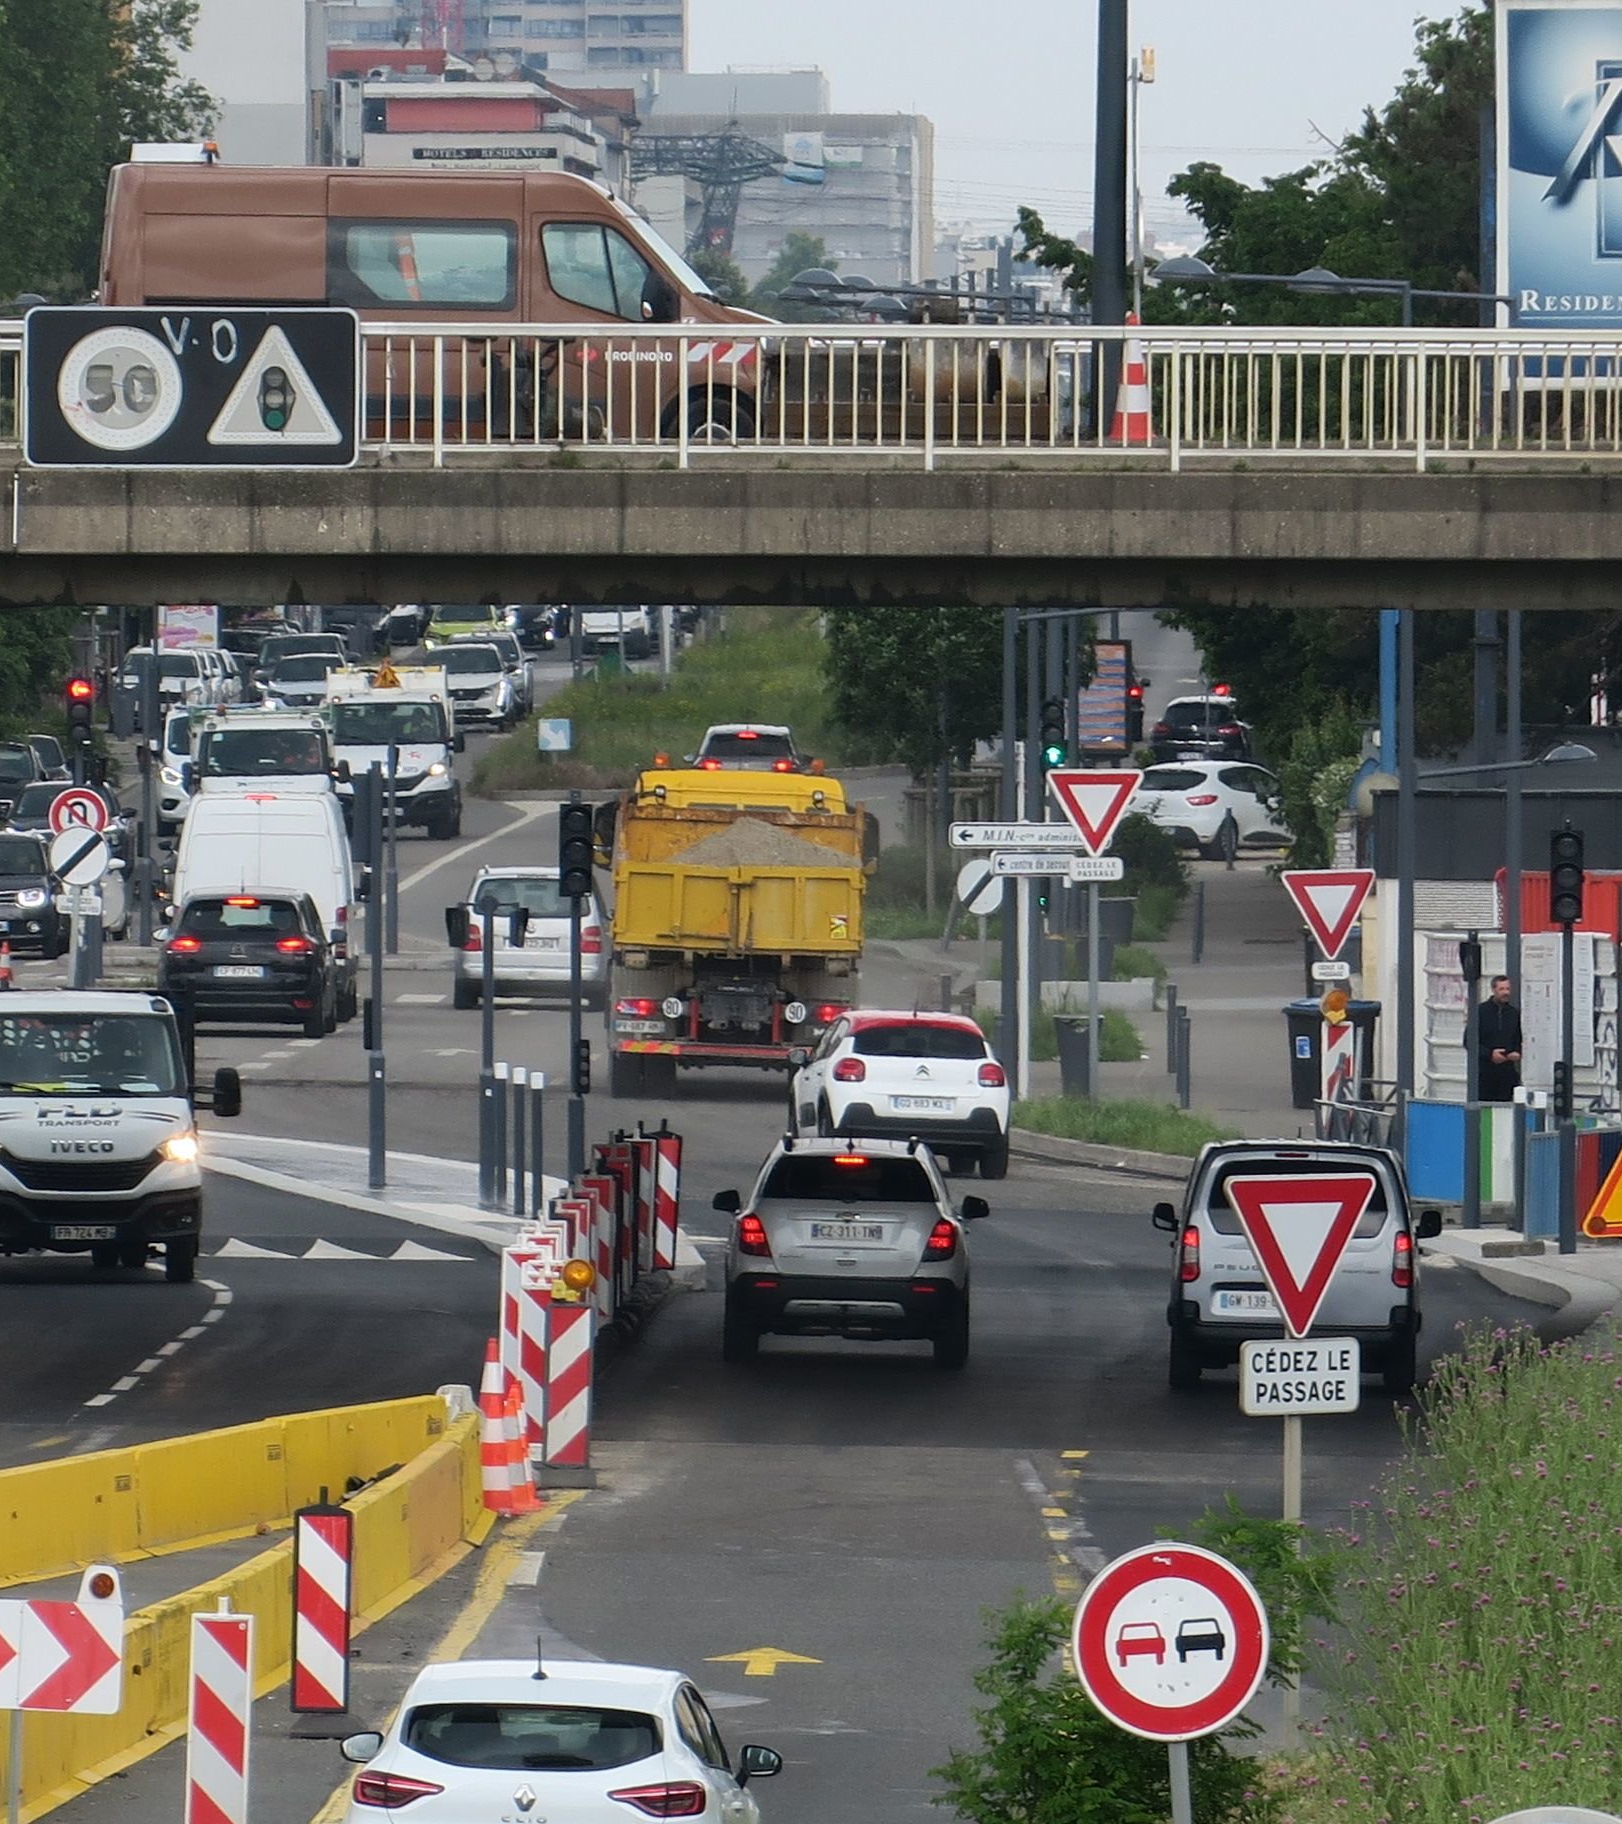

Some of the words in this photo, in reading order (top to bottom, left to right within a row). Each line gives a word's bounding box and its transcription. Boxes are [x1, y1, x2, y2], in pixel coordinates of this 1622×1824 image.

[788, 1005, 804, 1021] 90
[38, 1119, 120, 1128] TRANSPORT
[50, 1139, 114, 1154] IVECO
[1251, 1348, 1318, 1374] CÉDEZ
[1328, 1350, 1351, 1371] LE
[1255, 1380, 1347, 1404] PASSAGE
[501, 1816, 548, 1824] CLIO
